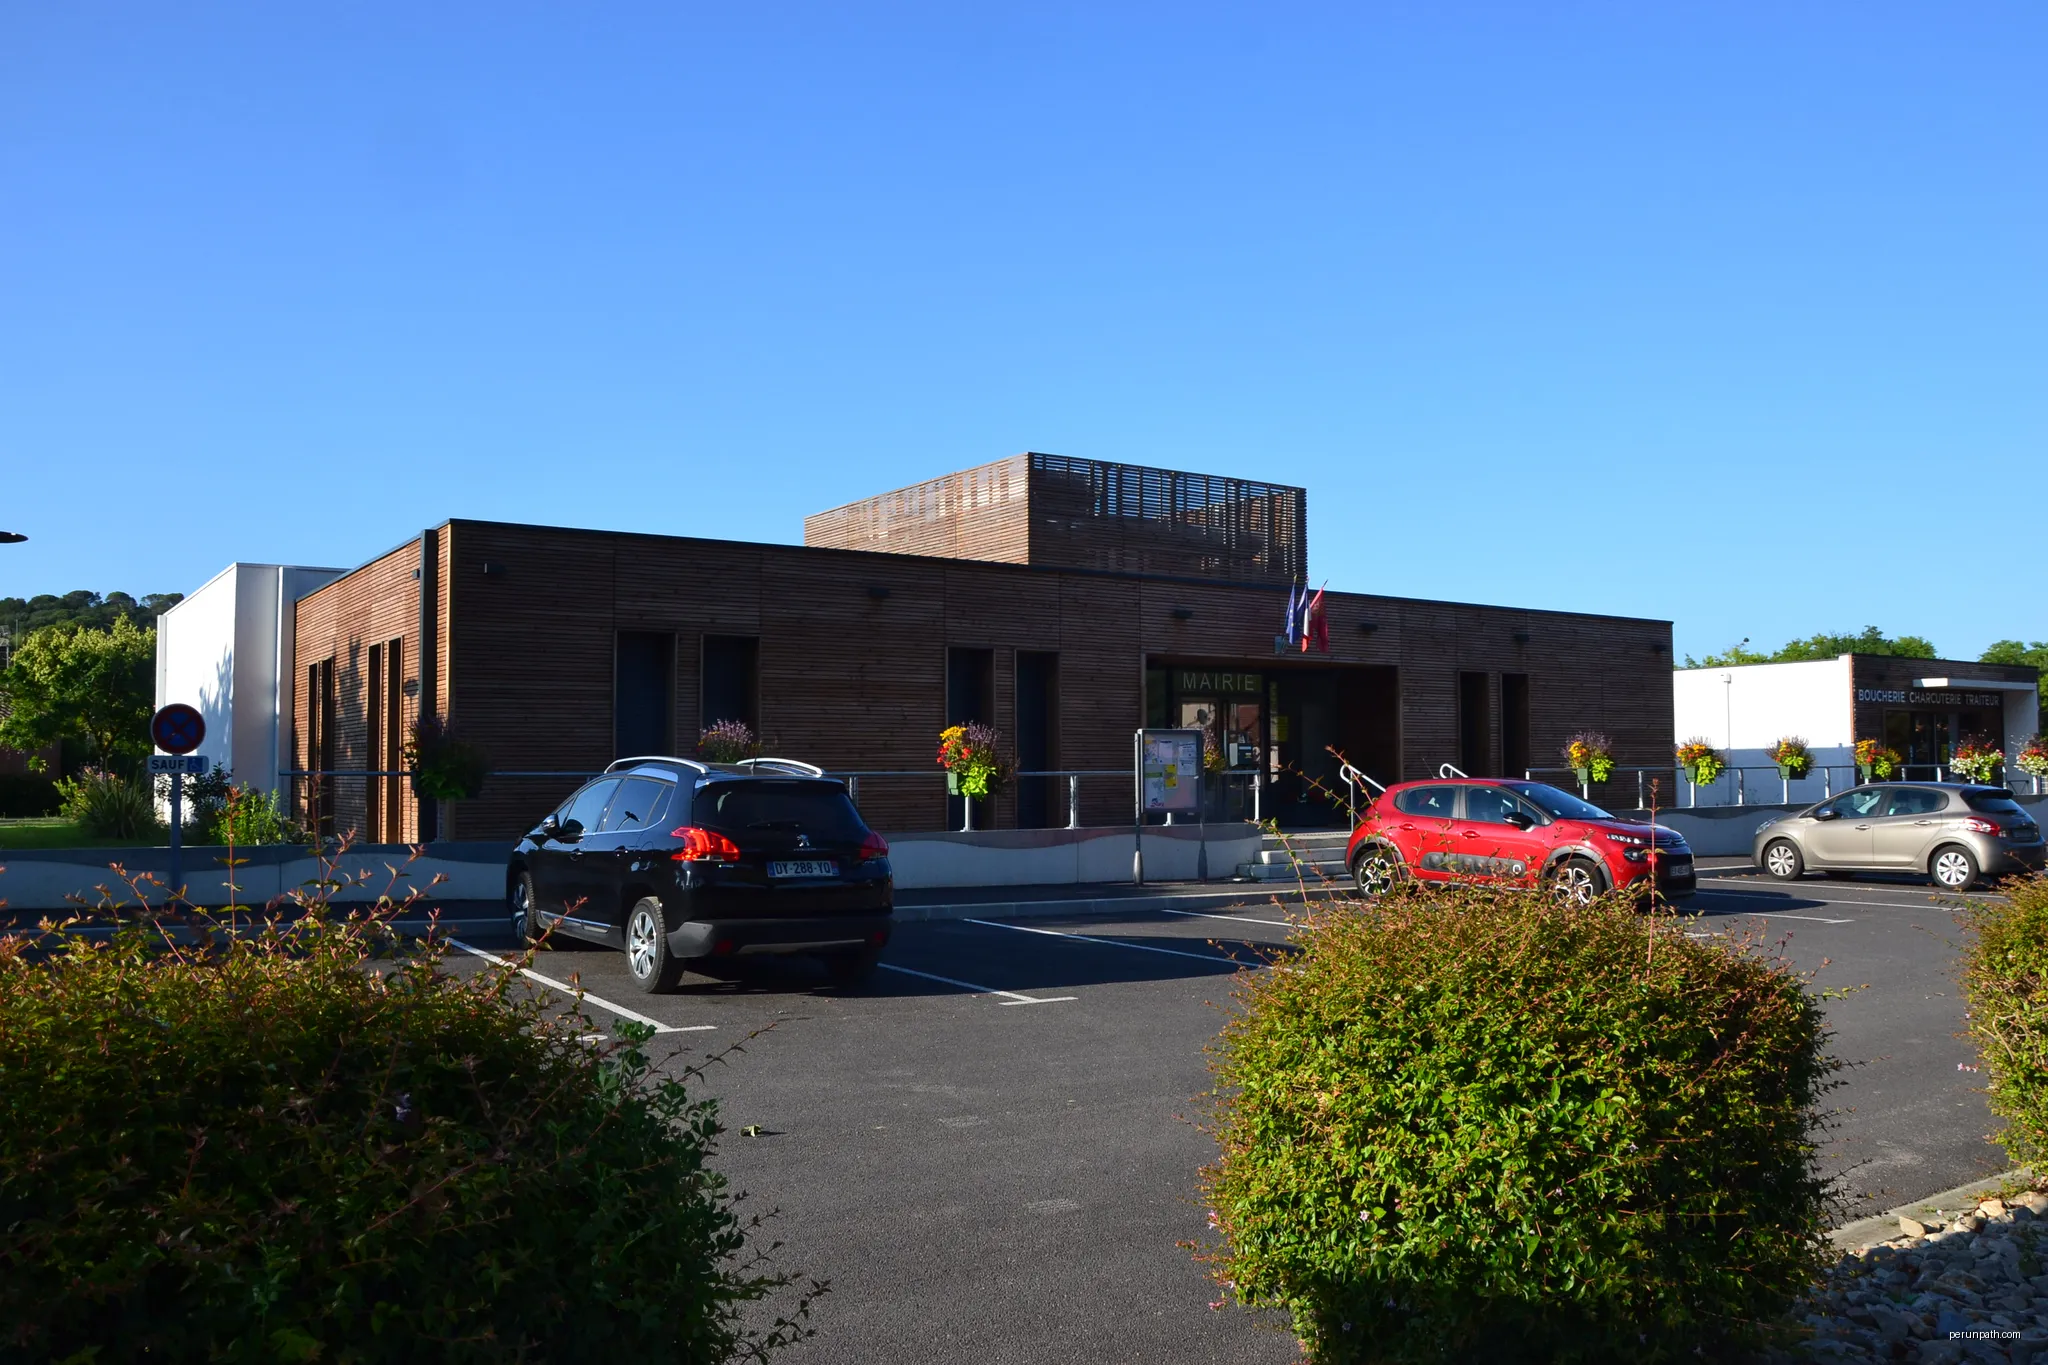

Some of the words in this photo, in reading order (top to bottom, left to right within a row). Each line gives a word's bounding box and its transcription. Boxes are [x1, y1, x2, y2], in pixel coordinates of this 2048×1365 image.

[1183, 672, 1255, 691] MAIRIE
[1858, 689, 1906, 703] BOUCHERIE
[1909, 691, 1962, 705] CHARCUTERIE
[1965, 694, 2000, 706] TRAITEUR
[151, 759, 185, 770] SAUF
